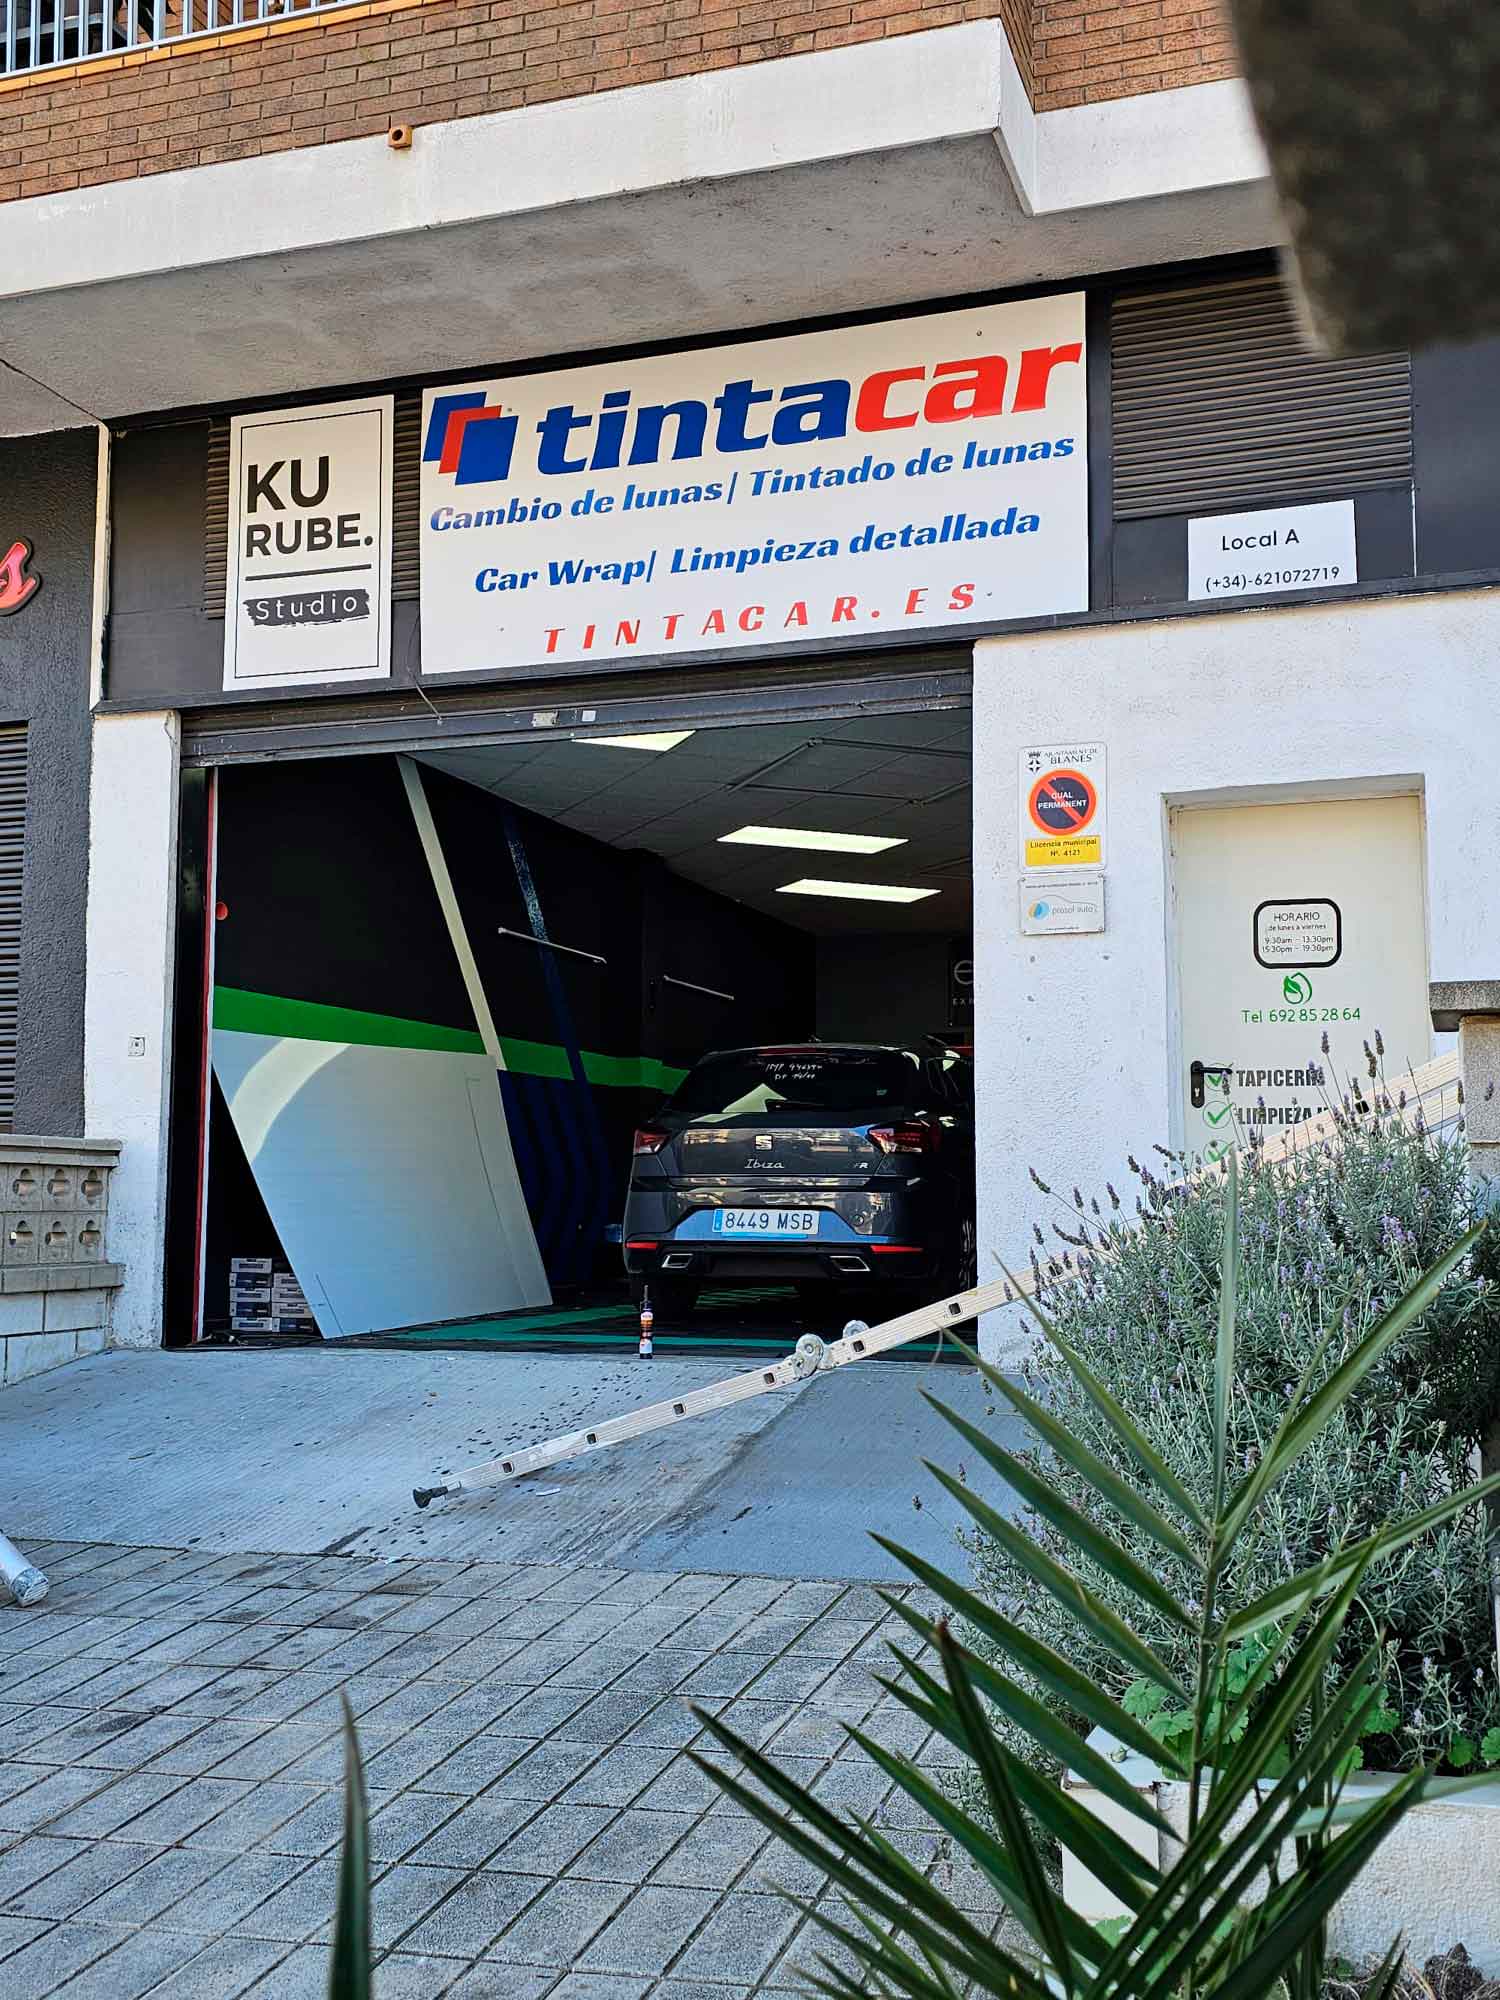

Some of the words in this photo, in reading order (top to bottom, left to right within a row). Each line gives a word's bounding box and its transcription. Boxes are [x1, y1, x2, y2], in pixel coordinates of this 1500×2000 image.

[536, 342, 1083, 475] tintacar
[247, 455, 330, 514] KU
[430, 497, 561, 531] Cambio
[570, 489, 613, 516] de
[750, 455, 895, 497] Tintado
[905, 447, 953, 477] de
[962, 437, 1074, 470] lunas
[246, 513, 374, 558] RUBE.
[1222, 530, 1277, 551] Local
[1285, 528, 1300, 545] A
[475, 567, 538, 593] Car
[670, 537, 840, 574] Limpieza
[849, 506, 1041, 554] detallada
[1205, 566, 1340, 593] (+34)-621072719
[255, 592, 358, 620] Studio
[1050, 754, 1093, 765] BLANES
[1038, 799, 1087, 809] PERMANENT
[1274, 912, 1320, 921] HORARIO
[1241, 1009, 1262, 1023] Tel
[1269, 1008, 1296, 1022] 692
[1299, 1008, 1318, 1021] 85
[1321, 1008, 1339, 1021] 28
[1342, 1007, 1361, 1021] 64
[744, 1158, 785, 1169] Ibiza
[725, 1212, 769, 1230] 8449
[777, 1213, 813, 1231] MSB
